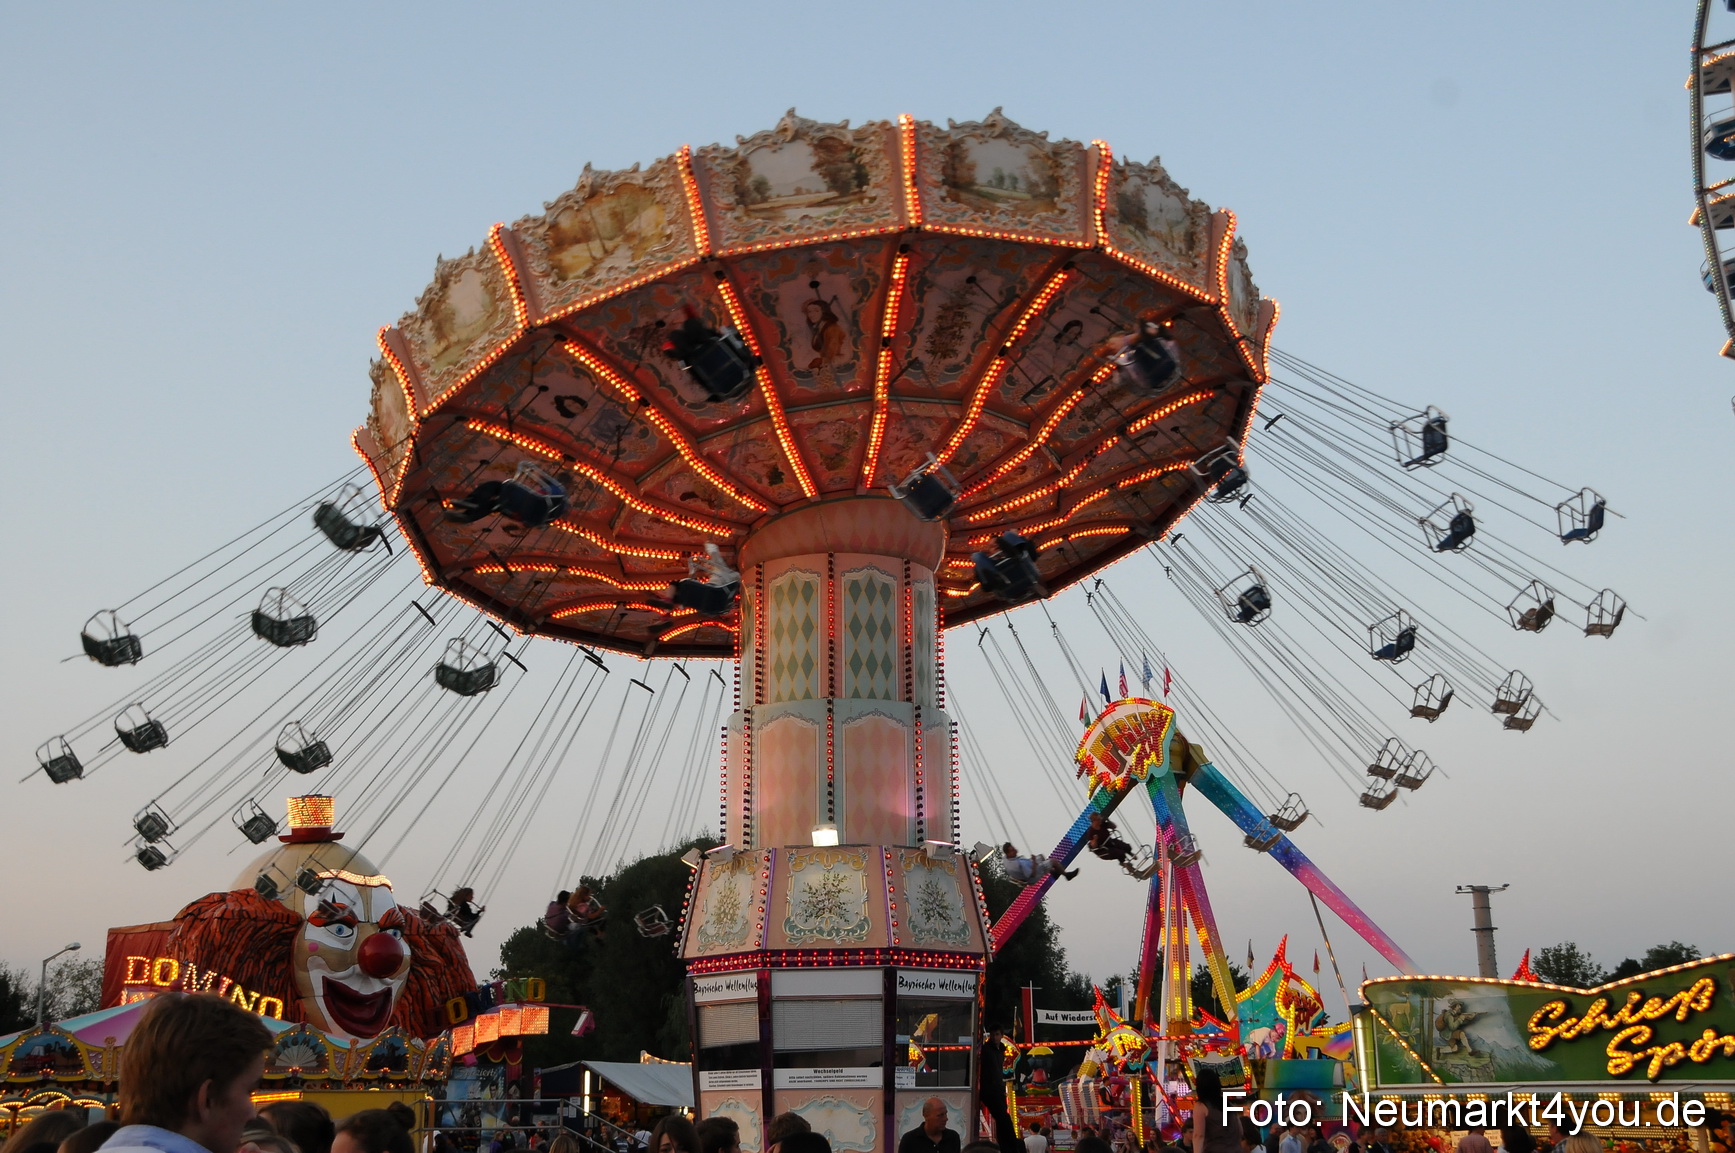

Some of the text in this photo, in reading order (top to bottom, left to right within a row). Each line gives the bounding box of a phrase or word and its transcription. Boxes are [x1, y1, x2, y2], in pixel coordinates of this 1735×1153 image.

[124, 955, 283, 1020] DOMINO
[725, 978, 757, 992] Wellenflug
[898, 976, 977, 994] Bayrischer Wellenflug
[1045, 1013, 1058, 1021] Auf
[1527, 977, 1715, 1050] Schieß
